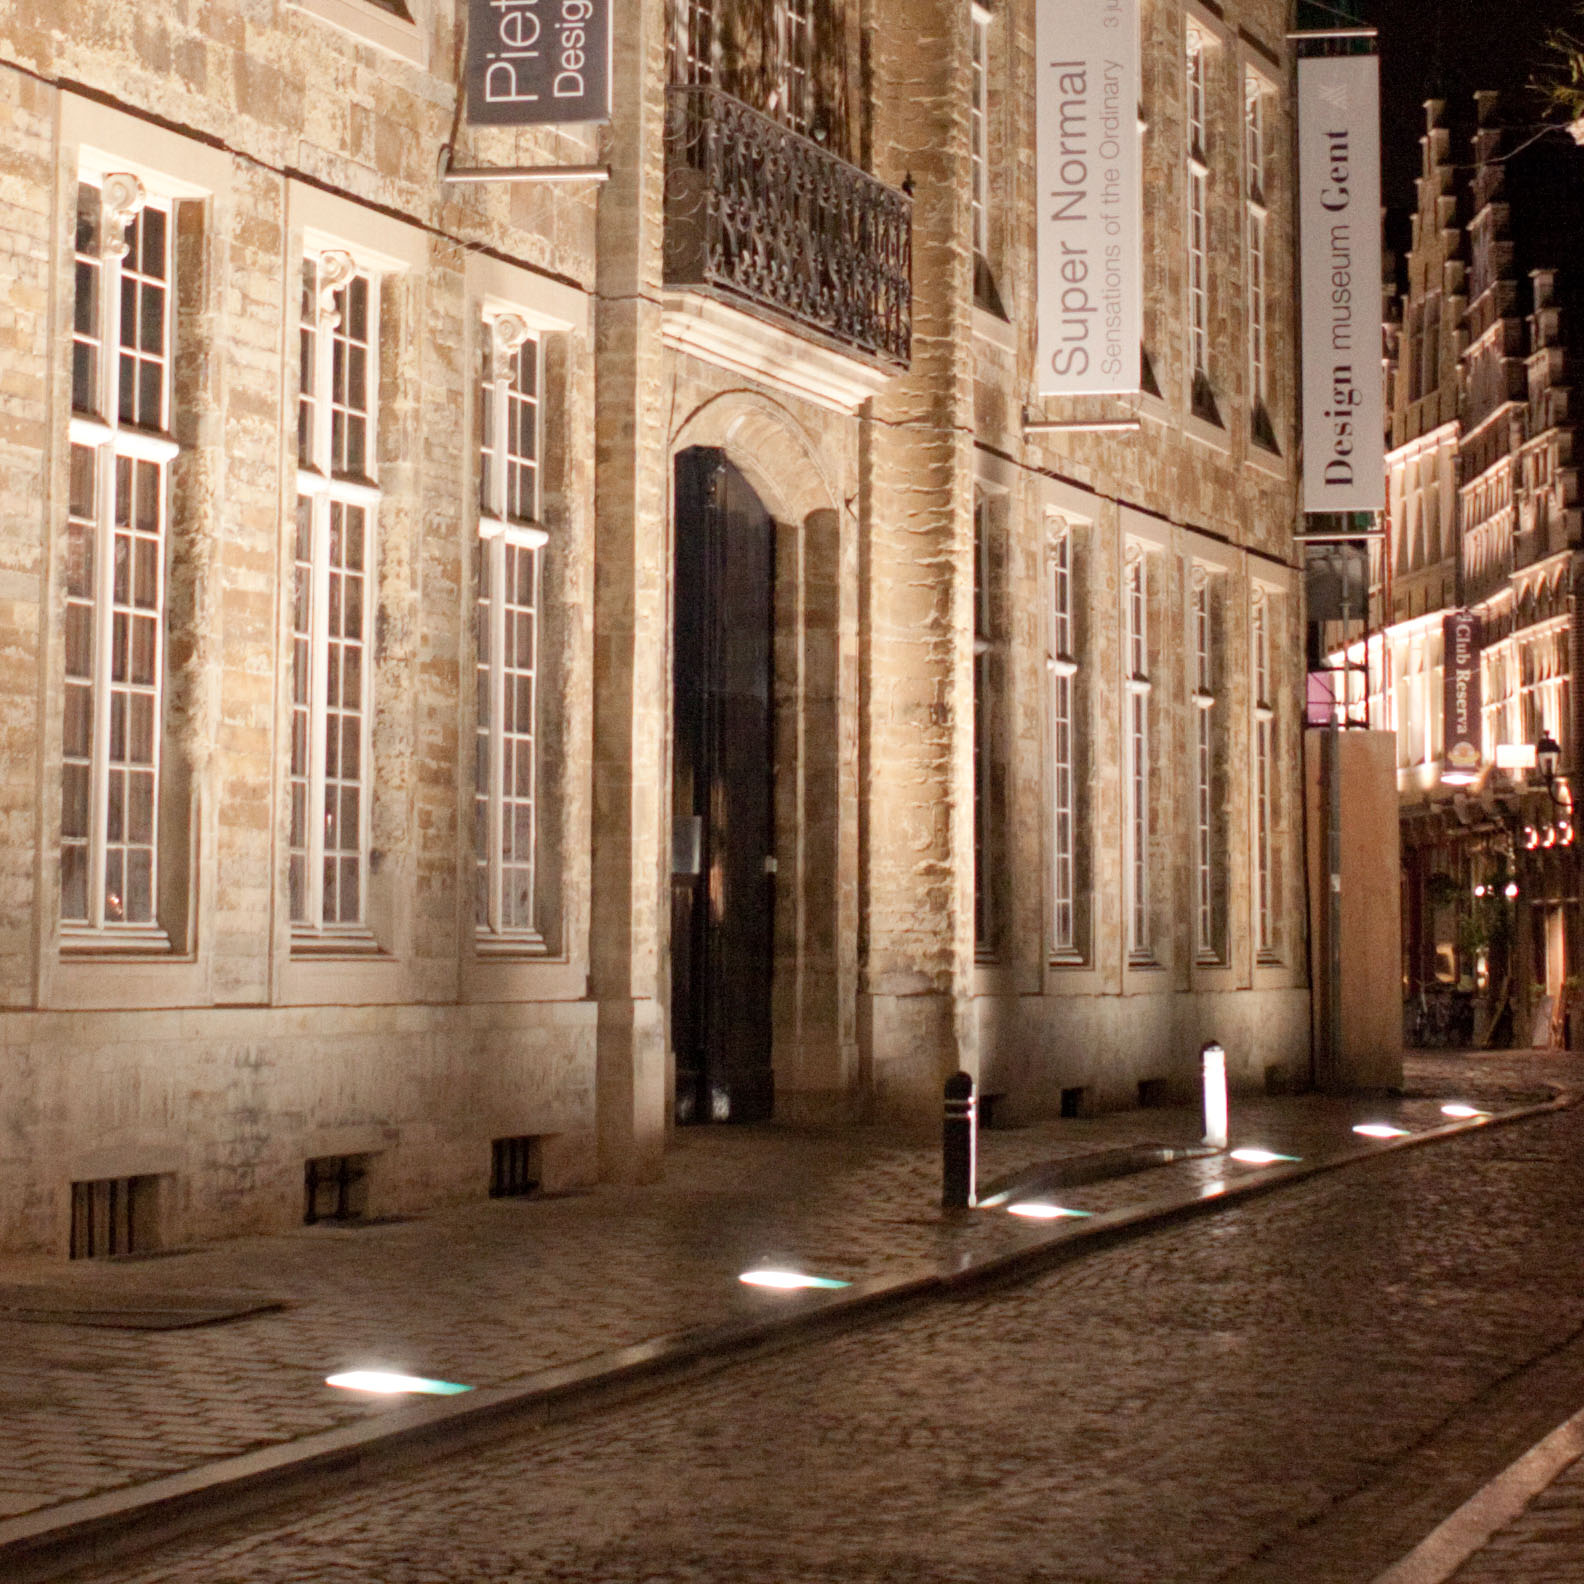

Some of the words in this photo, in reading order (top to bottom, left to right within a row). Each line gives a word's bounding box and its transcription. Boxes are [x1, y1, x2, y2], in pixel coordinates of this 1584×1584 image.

[1104, 18, 1119, 28] 3
[1050, 60, 1088, 221] Normal
[1099, 59, 1124, 159] Ordinary
[1100, 168, 1121, 205] the
[1320, 128, 1351, 212] Gent
[1100, 213, 1121, 235] of
[1051, 240, 1097, 376] Super
[1328, 225, 1351, 350] museum
[1324, 365, 1361, 487] Design
[1456, 624, 1471, 664] Club
[1456, 669, 1471, 734] Reserva
